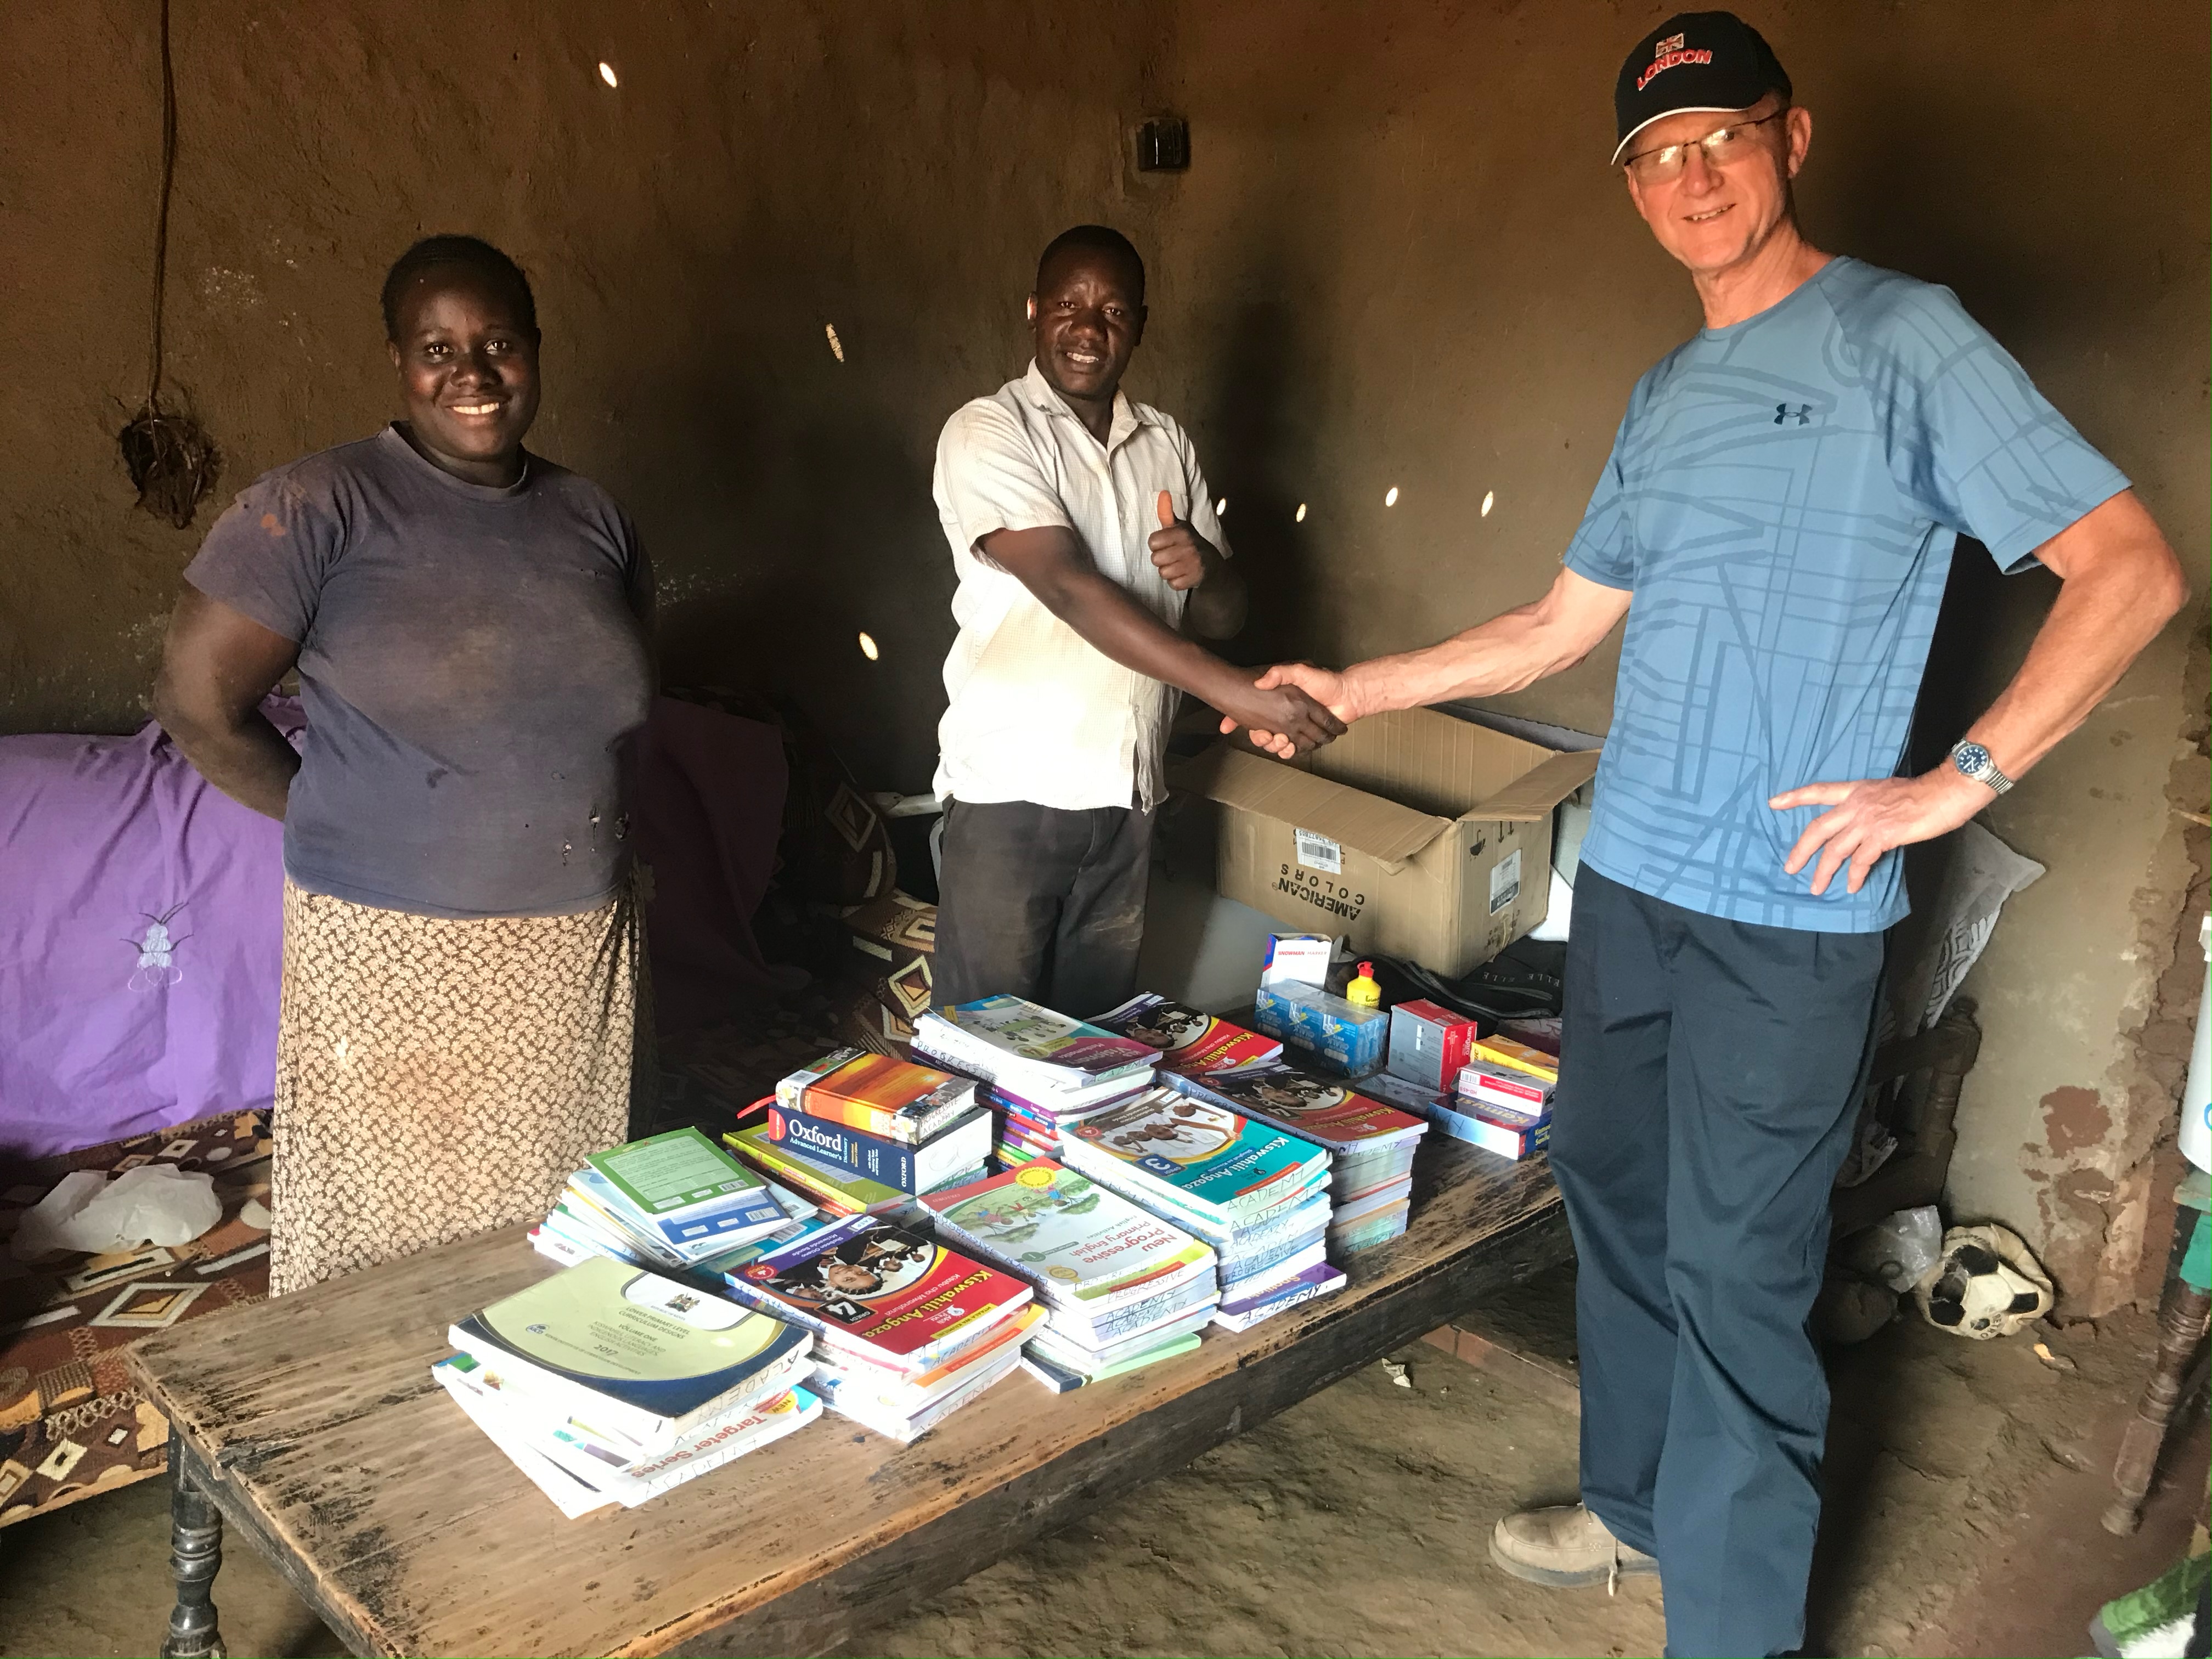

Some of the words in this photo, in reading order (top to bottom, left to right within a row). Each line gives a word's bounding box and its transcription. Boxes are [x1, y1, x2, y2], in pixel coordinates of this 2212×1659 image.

[1637, 48, 1713, 91] LONDON
[1281, 864, 1364, 905] COLORS
[1278, 877, 1361, 921] AMERICAN
[1527, 973, 1560, 988] ELLE
[1058, 1042, 1105, 1059] Mathematics
[1206, 1032, 1254, 1062] Kiswahili
[1465, 1026, 1474, 1056] kangaro
[917, 1041, 999, 1085] PROGRESSIVE
[920, 1097, 960, 1127] PROGRESSIVE
[1338, 1108, 1395, 1127] Kiswahili
[1455, 1097, 1530, 1125] Kamusi
[923, 1110, 955, 1135] ACADEMY
[789, 1119, 842, 1152] Oxford
[790, 1137, 816, 1151] Advanced
[816, 1146, 842, 1160] Learner's
[1232, 1136, 1289, 1172] Kiswahili
[1145, 1158, 1170, 1170] 3
[1181, 1167, 1234, 1190] Angaza
[1115, 1215, 1137, 1227] English
[1086, 1225, 1115, 1239] Activities
[1105, 1221, 1151, 1242] Primary
[792, 1245, 810, 1256] Banda
[801, 1248, 821, 1257] Otieno
[821, 1237, 844, 1250] Shabaan
[1069, 1239, 1109, 1257] English
[1082, 1227, 1165, 1263] Progressive
[1142, 1234, 1177, 1252] New
[924, 1286, 939, 1295] cha
[937, 1273, 961, 1288] Kitabu
[919, 1270, 993, 1312] Kiswahili
[826, 1301, 857, 1316] 4
[1239, 1284, 1322, 1323] ACADEMY
[619, 1311, 659, 1329] CURRICULUM
[658, 1326, 686, 1340] DESIGNS
[626, 1307, 648, 1319] LOWER
[647, 1313, 674, 1329] PRIMARY
[673, 1325, 690, 1335] LEVEL
[850, 1311, 870, 1323] GREDI
[861, 1308, 925, 1338] Angaza
[930, 1312, 947, 1322] Pevu
[936, 1314, 952, 1325] Akili
[590, 1331, 617, 1346] ENGLISH
[619, 1323, 644, 1338] VOLUME
[643, 1334, 658, 1342] ONE
[594, 1344, 619, 1356] 2017
[653, 1344, 666, 1353] AND
[772, 1398, 791, 1413] NEW
[693, 1415, 768, 1452] Targeter
[631, 1451, 693, 1478] Series
